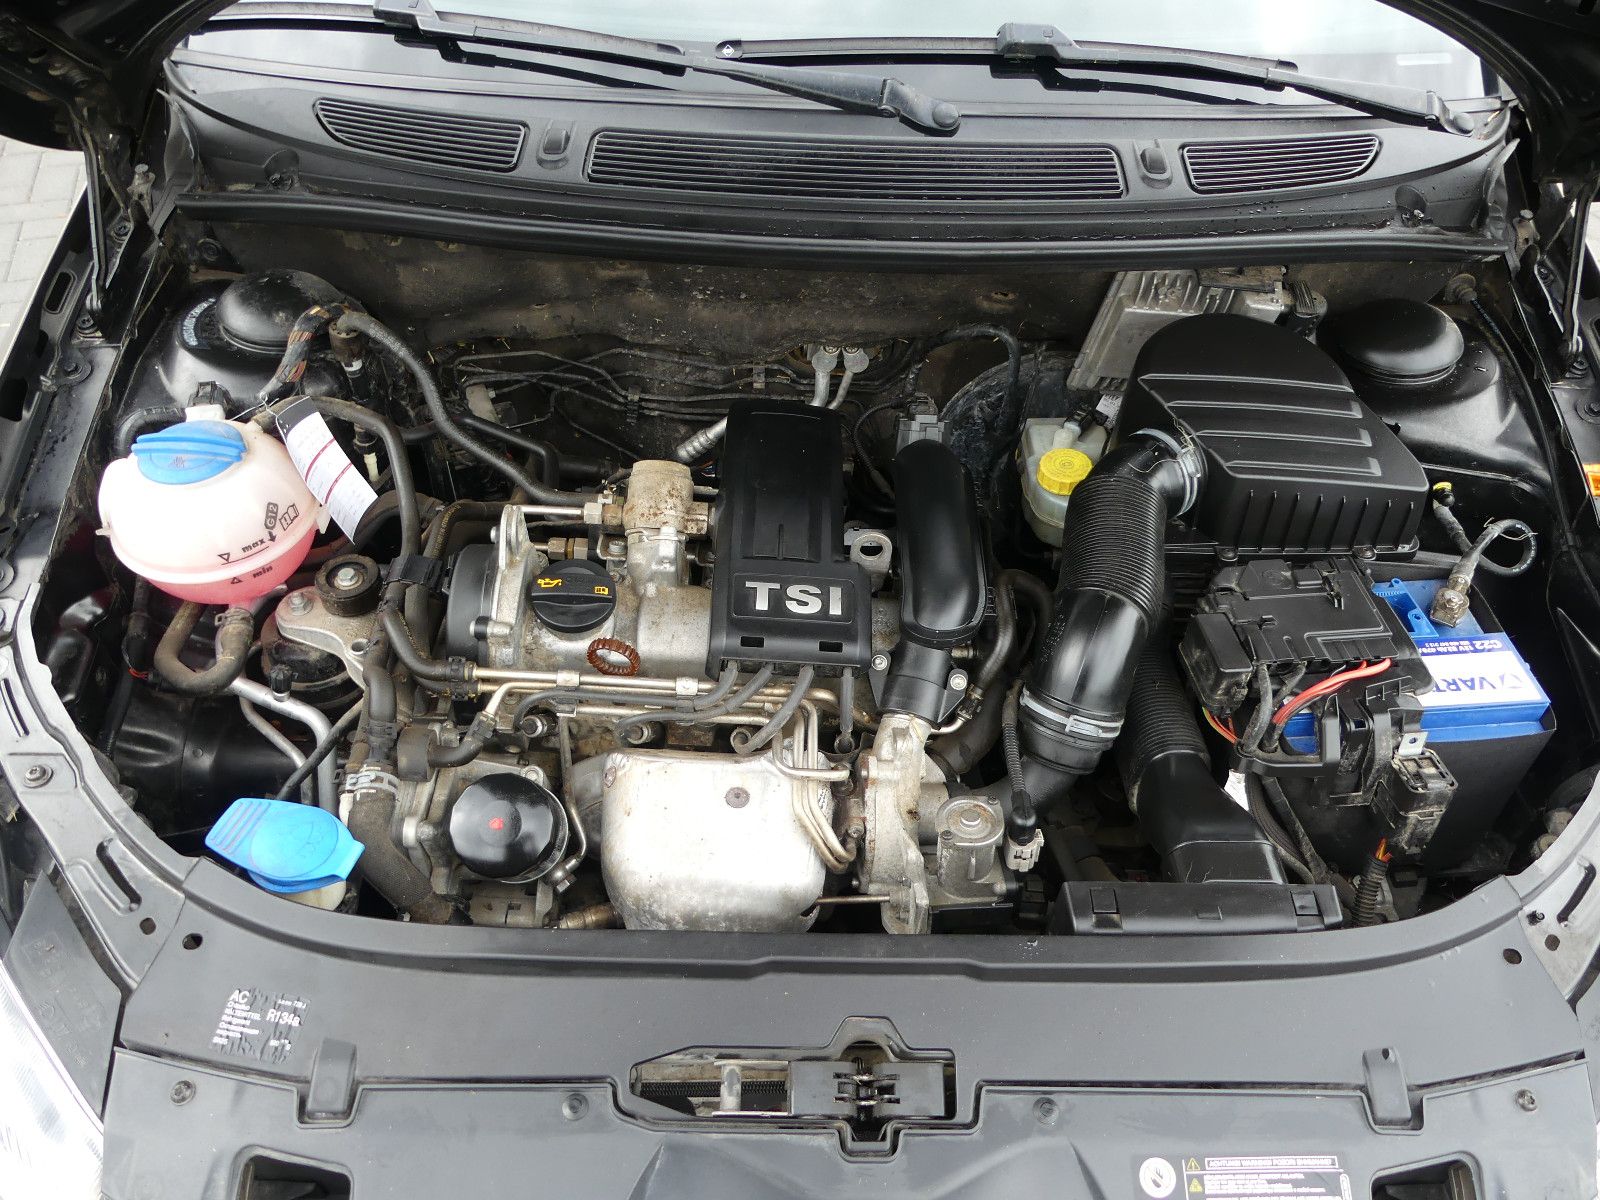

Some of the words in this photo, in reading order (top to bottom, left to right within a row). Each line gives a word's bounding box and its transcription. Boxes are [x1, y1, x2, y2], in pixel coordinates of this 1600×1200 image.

[241, 539, 265, 552] max
[253, 566, 272, 578] min
[745, 581, 842, 615] TSI
[1473, 640, 1503, 650] C22
[1433, 676, 1497, 693] VART
[229, 989, 250, 1004] AC
[265, 1008, 301, 1027] R134a
